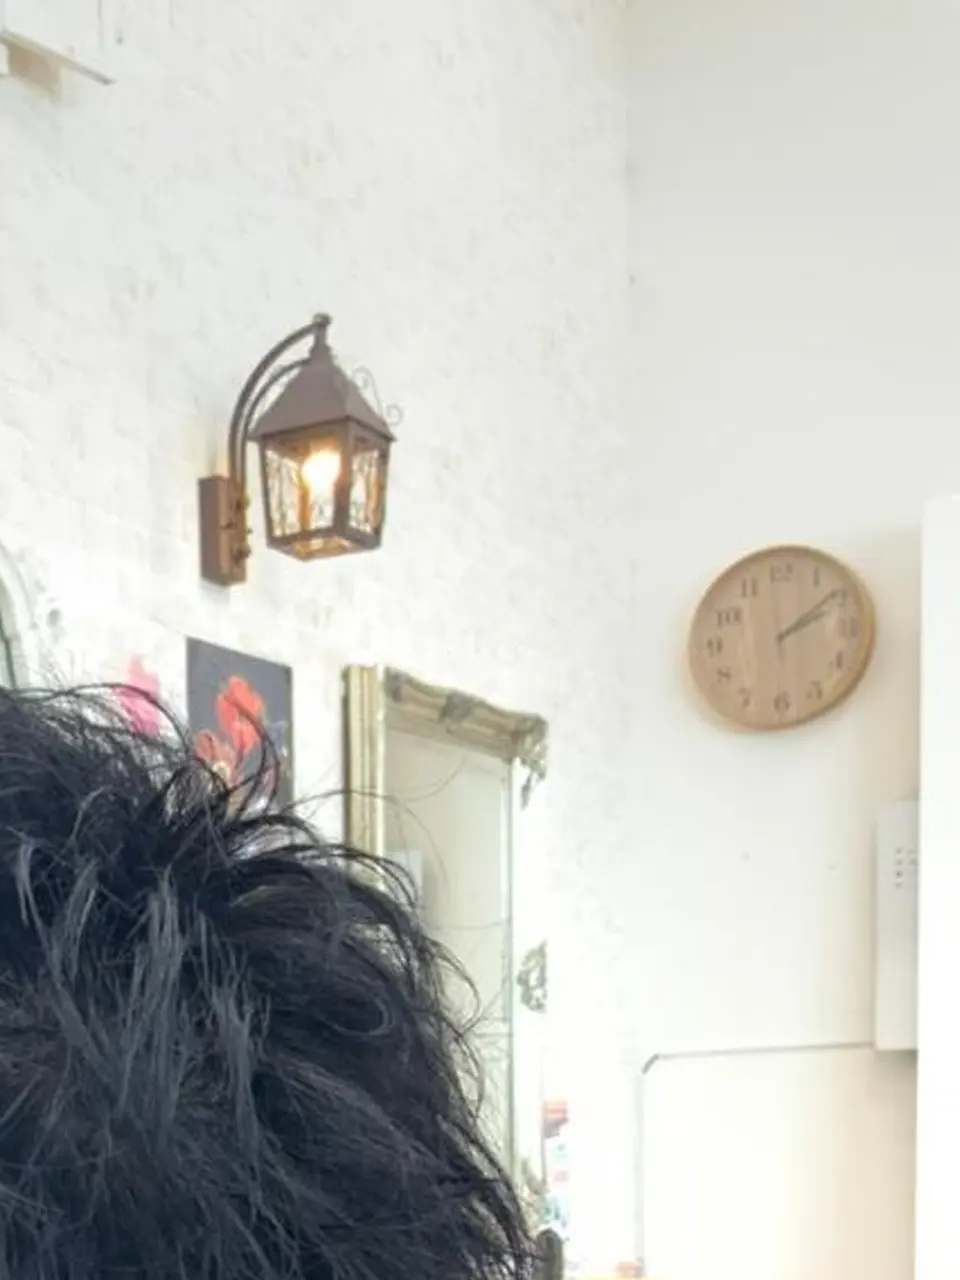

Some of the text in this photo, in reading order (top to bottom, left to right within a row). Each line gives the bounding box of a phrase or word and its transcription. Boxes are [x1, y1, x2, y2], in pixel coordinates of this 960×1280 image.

[770, 563, 793, 583] 12
[742, 576, 758, 597] 11
[716, 608, 741, 628] 10
[706, 635, 722, 657] 9
[773, 690, 792, 715] 6
